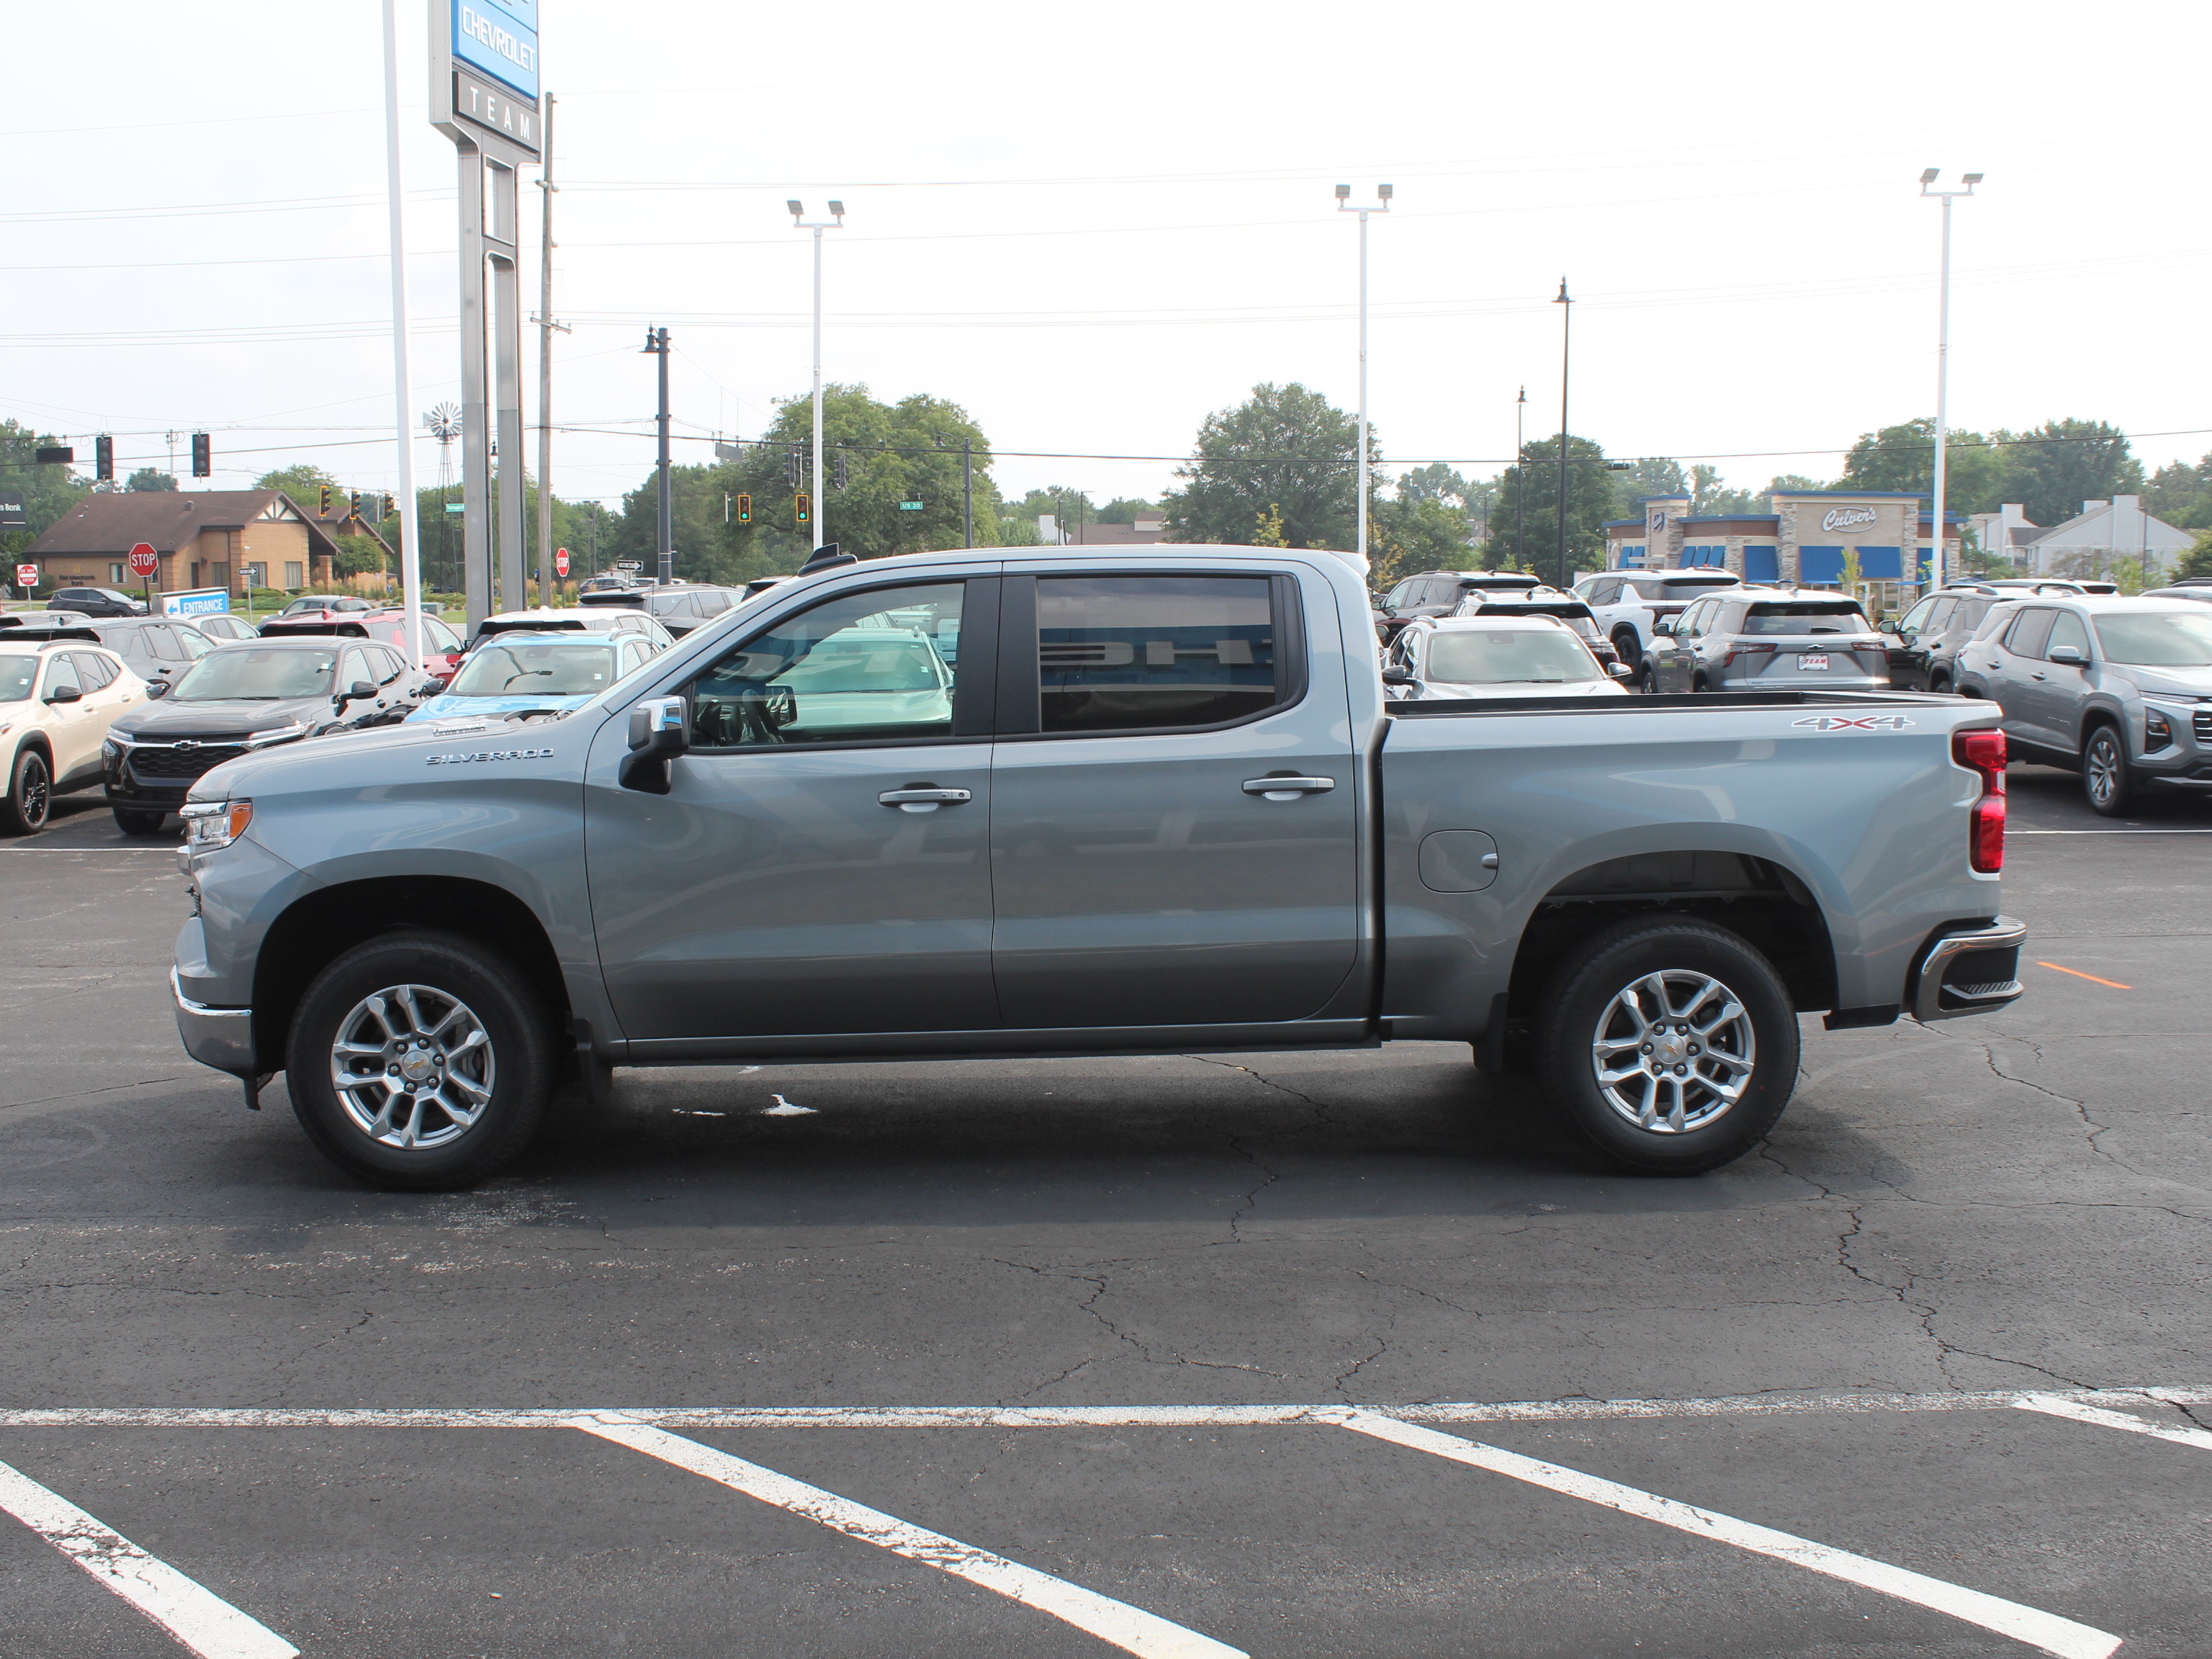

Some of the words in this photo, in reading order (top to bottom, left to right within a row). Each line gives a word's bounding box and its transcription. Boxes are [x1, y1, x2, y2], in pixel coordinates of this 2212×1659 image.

[462, 6, 535, 73] CHEVROLET
[470, 86, 530, 140] TEAM
[1822, 506, 1876, 531] Culver's
[132, 553, 156, 567] STOP
[557, 557, 569, 567] STOP
[183, 598, 223, 614] ENTRANCE
[426, 748, 554, 765] SILVERADO
